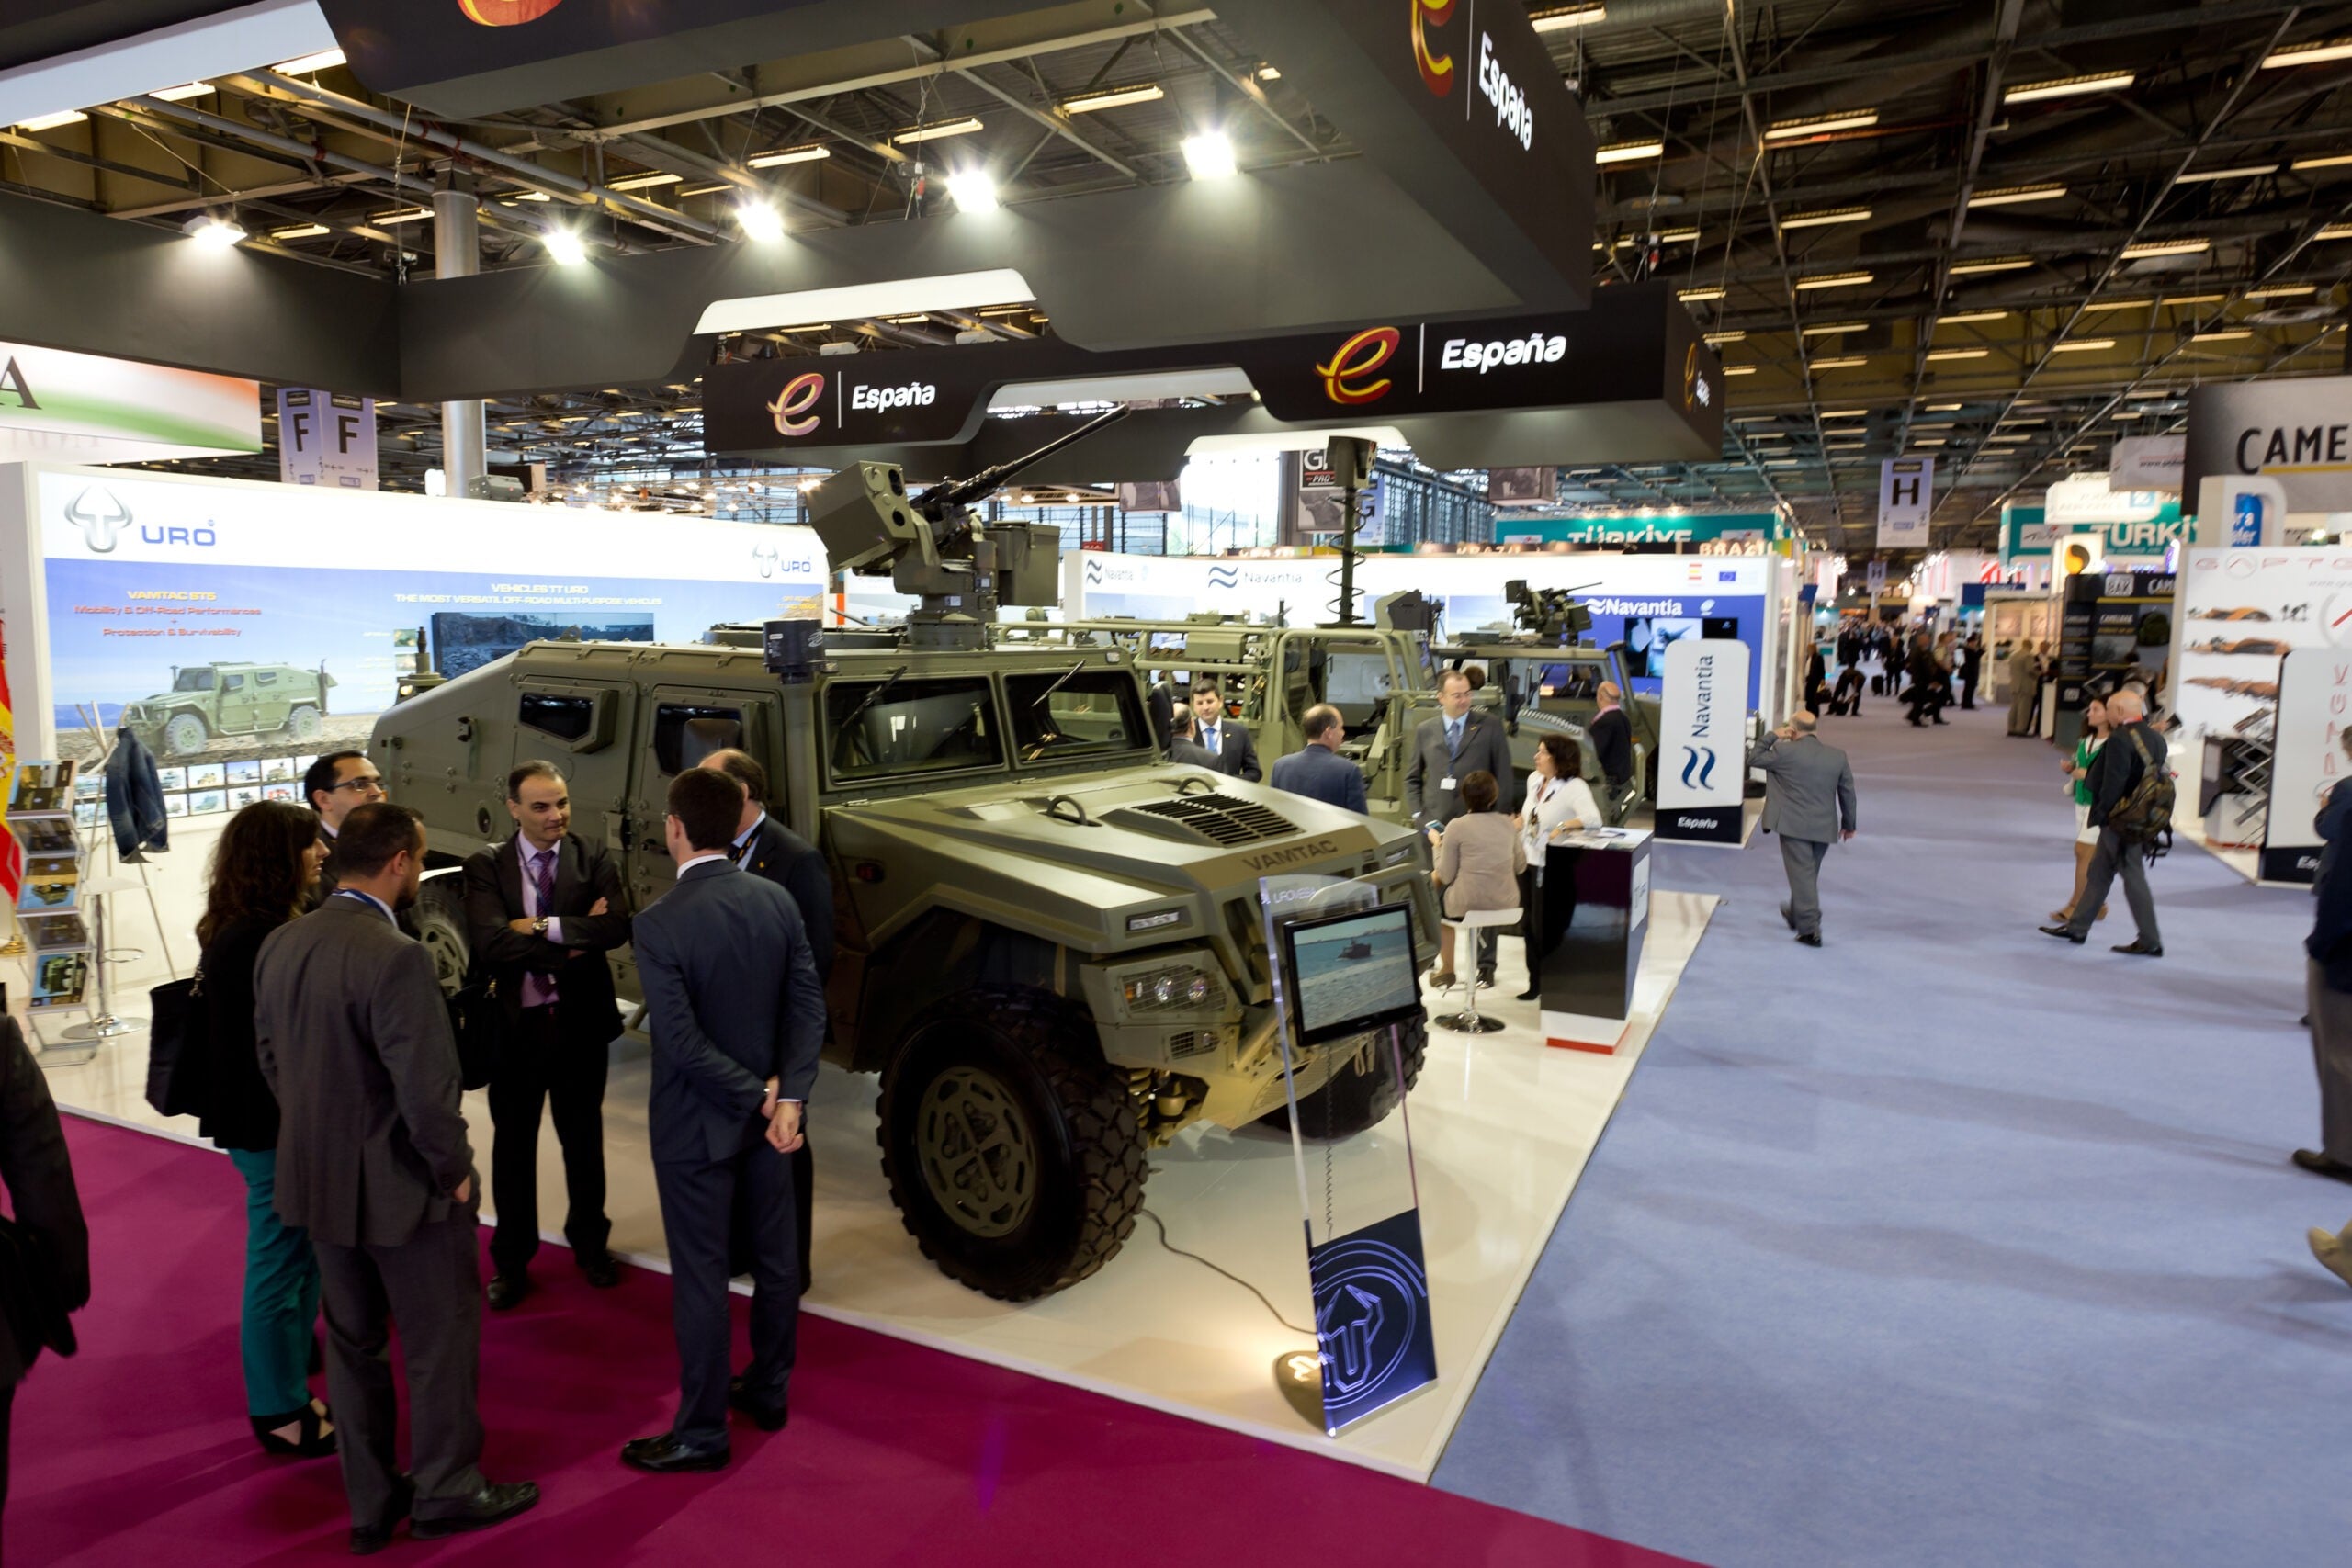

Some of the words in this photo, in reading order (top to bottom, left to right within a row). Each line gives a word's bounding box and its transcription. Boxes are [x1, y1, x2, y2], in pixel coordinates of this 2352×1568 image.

[1479, 30, 1532, 151] España
[1441, 333, 1566, 374] España
[852, 382, 936, 414] España
[293, 413, 309, 452] F
[338, 415, 359, 454] F
[2236, 424, 2349, 475] CAME
[1312, 474, 1331, 483] PRO
[1892, 478, 1919, 506] H
[141, 525, 216, 547] URO
[781, 559, 811, 573] URO
[1243, 571, 1303, 583] Navantia
[128, 591, 187, 601] VAMTAC
[491, 583, 548, 592] VEHICLES
[565, 585, 588, 593] URO
[419, 594, 451, 603] MOST
[1607, 598, 1683, 616] Navantia
[74, 605, 121, 615] Mobility
[178, 628, 241, 637] Survivability
[1692, 654, 1713, 738] Navantia
[1677, 816, 1718, 829] España
[1242, 840, 1339, 870] VAMTAC
